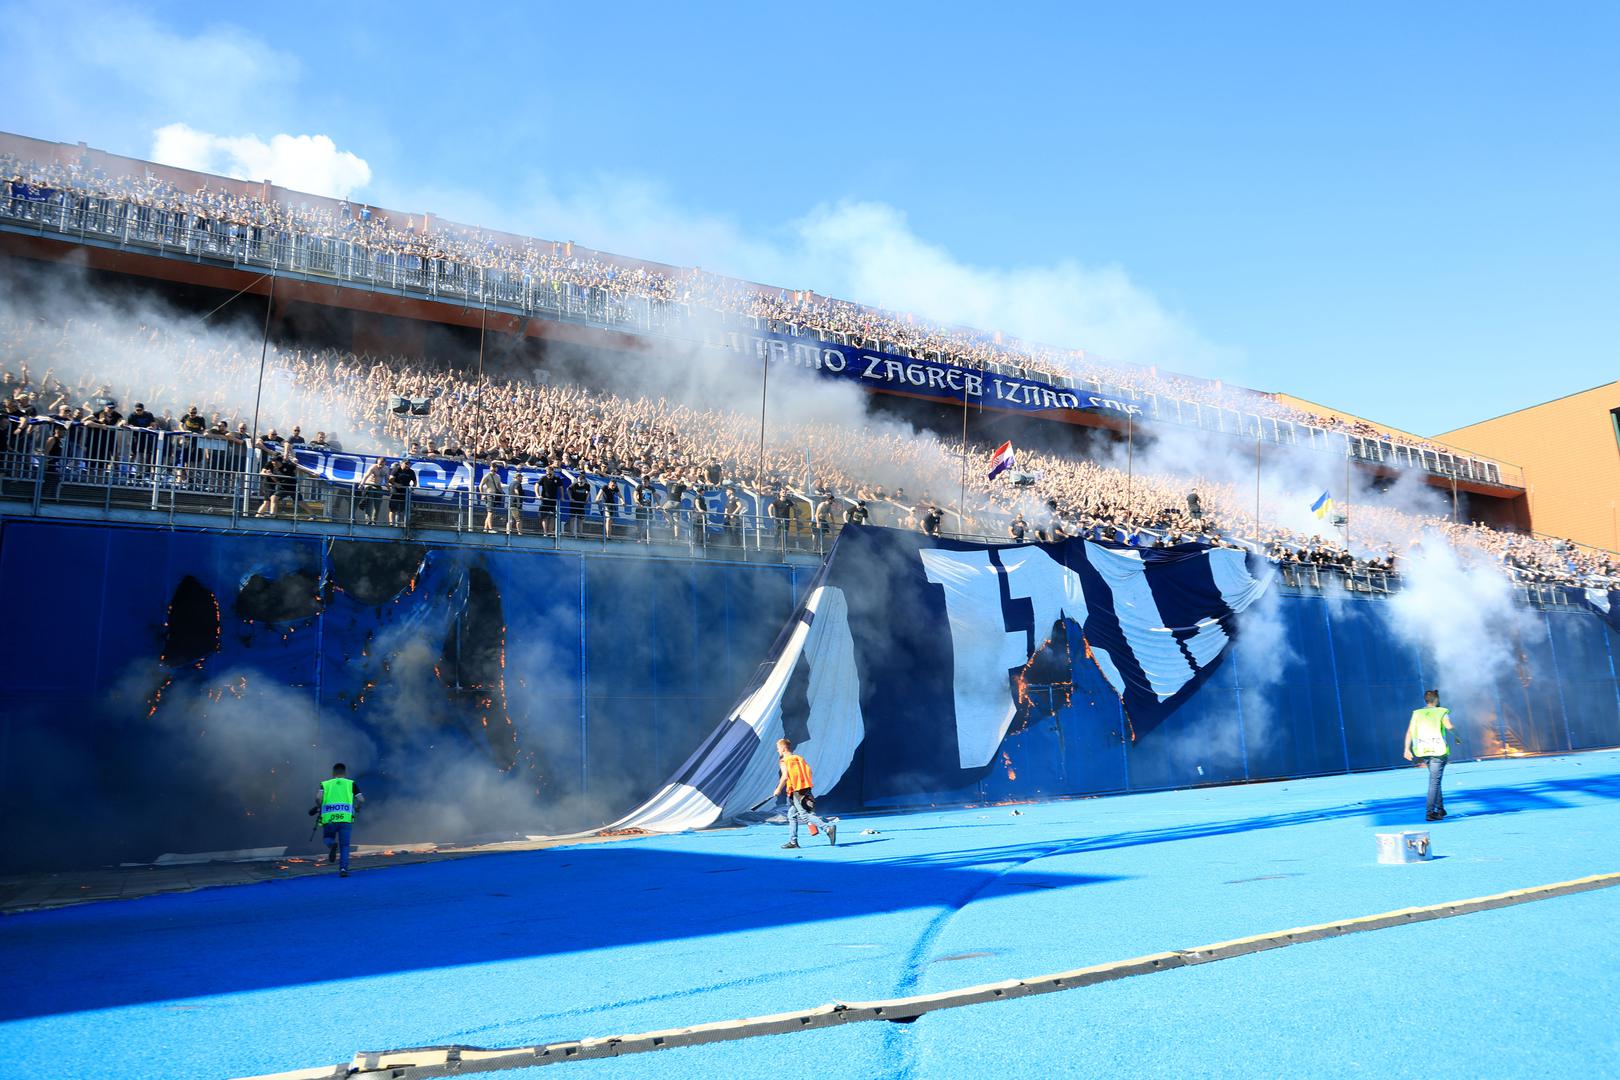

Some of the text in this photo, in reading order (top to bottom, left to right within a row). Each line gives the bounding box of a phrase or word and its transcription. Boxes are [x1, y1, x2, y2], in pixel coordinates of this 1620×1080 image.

[863, 355, 983, 396] ZAGREB
[993, 379, 1079, 409] IZNAD
[325, 804, 350, 812] PHOTO
